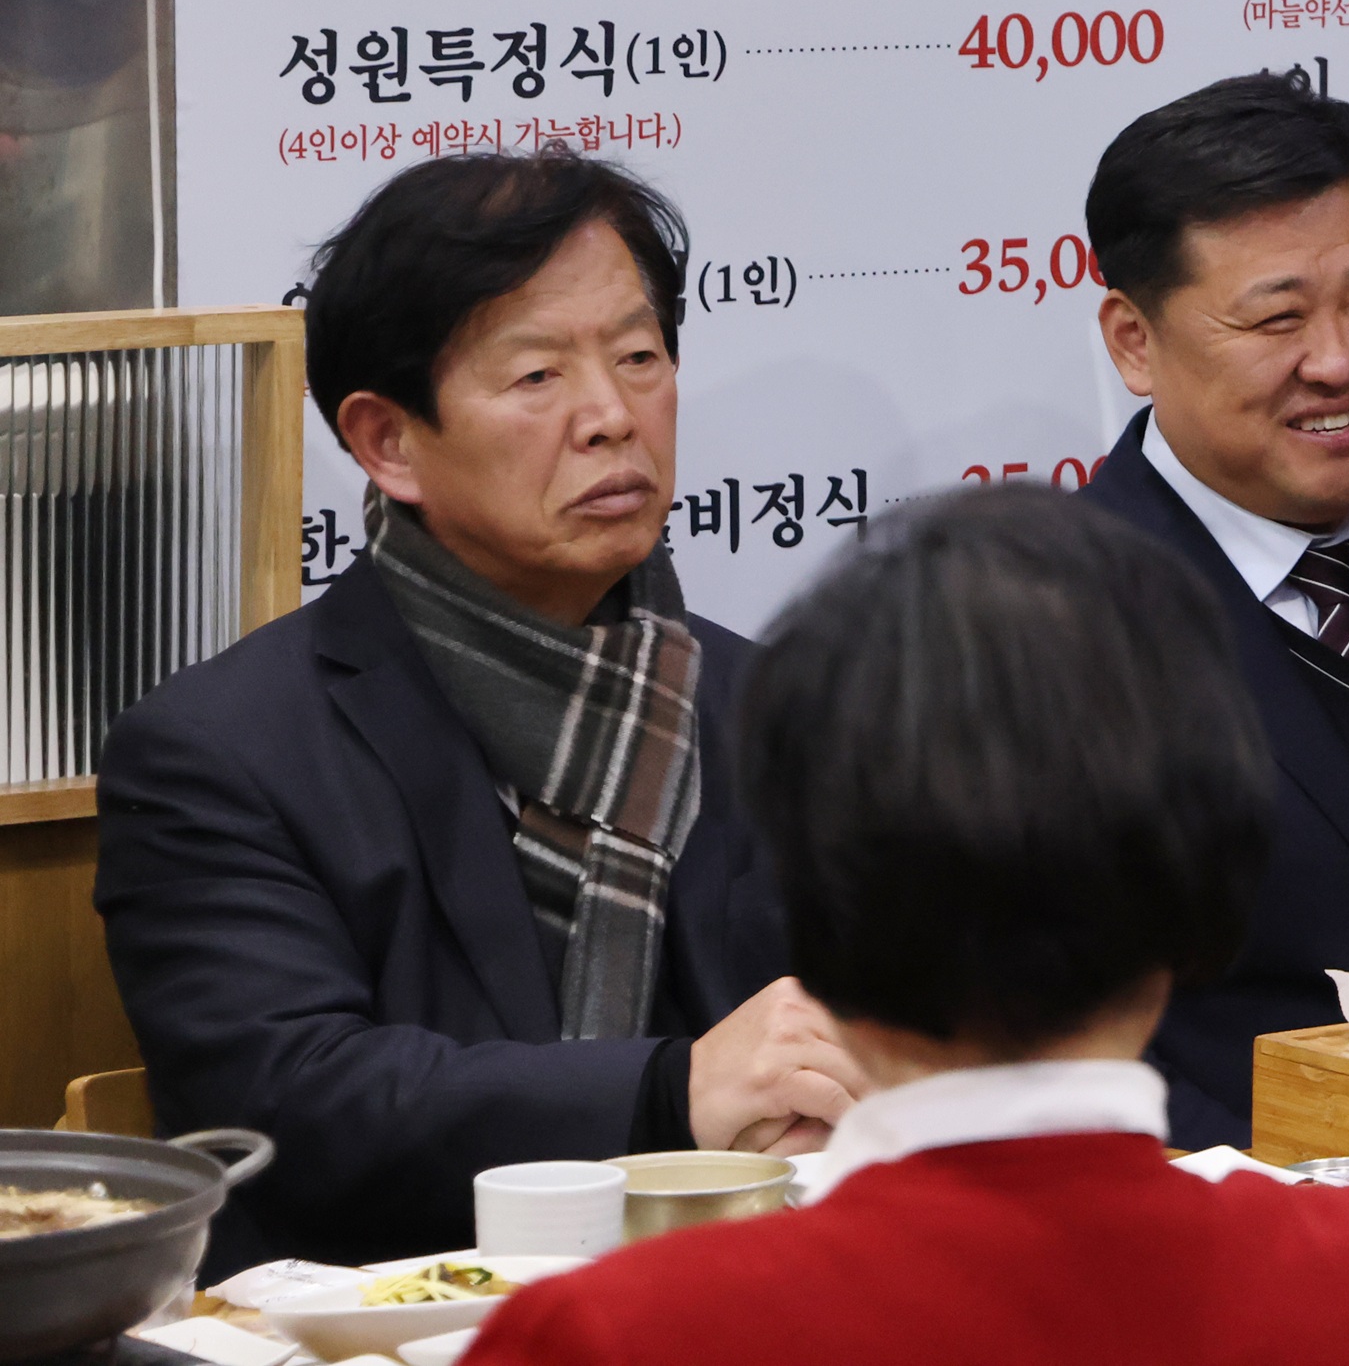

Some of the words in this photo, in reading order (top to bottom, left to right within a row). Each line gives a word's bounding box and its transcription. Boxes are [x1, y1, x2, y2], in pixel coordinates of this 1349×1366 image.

[958, 9, 1164, 82] 40,000
[279, 123, 402, 164] (4인이상
[412, 119, 501, 159] 예약시
[674, 250, 797, 324] (1인)
[667, 469, 868, 554] 비정식
